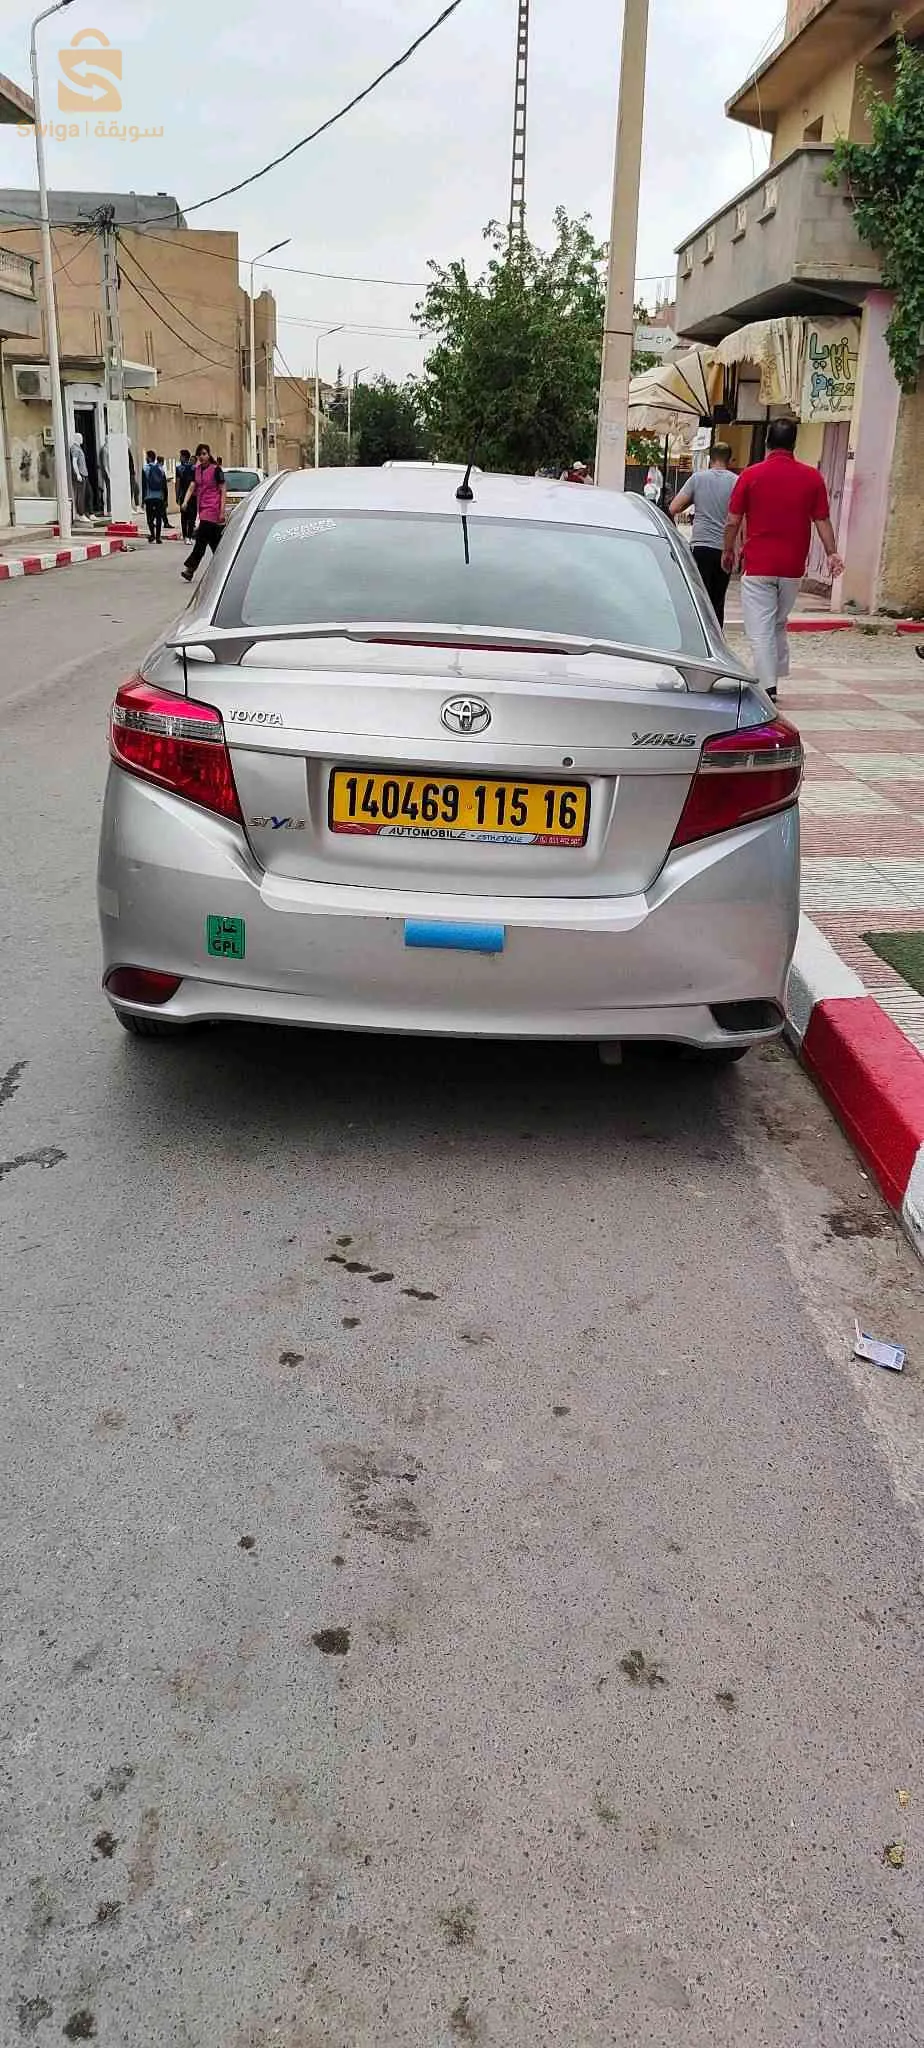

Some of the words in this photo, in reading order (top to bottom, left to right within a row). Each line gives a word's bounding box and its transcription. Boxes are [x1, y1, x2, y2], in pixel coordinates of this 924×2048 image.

[229, 710, 284, 726] TOYOTA
[631, 731, 697, 747] YARIS
[345, 777, 460, 823] 140469
[474, 784, 529, 827] 115
[544, 789, 578, 830] 16
[247, 816, 306, 830] STYLE
[388, 826, 467, 839] AUTOMOBILE
[215, 916, 238, 936] غاز
[212, 939, 240, 954] GPL
